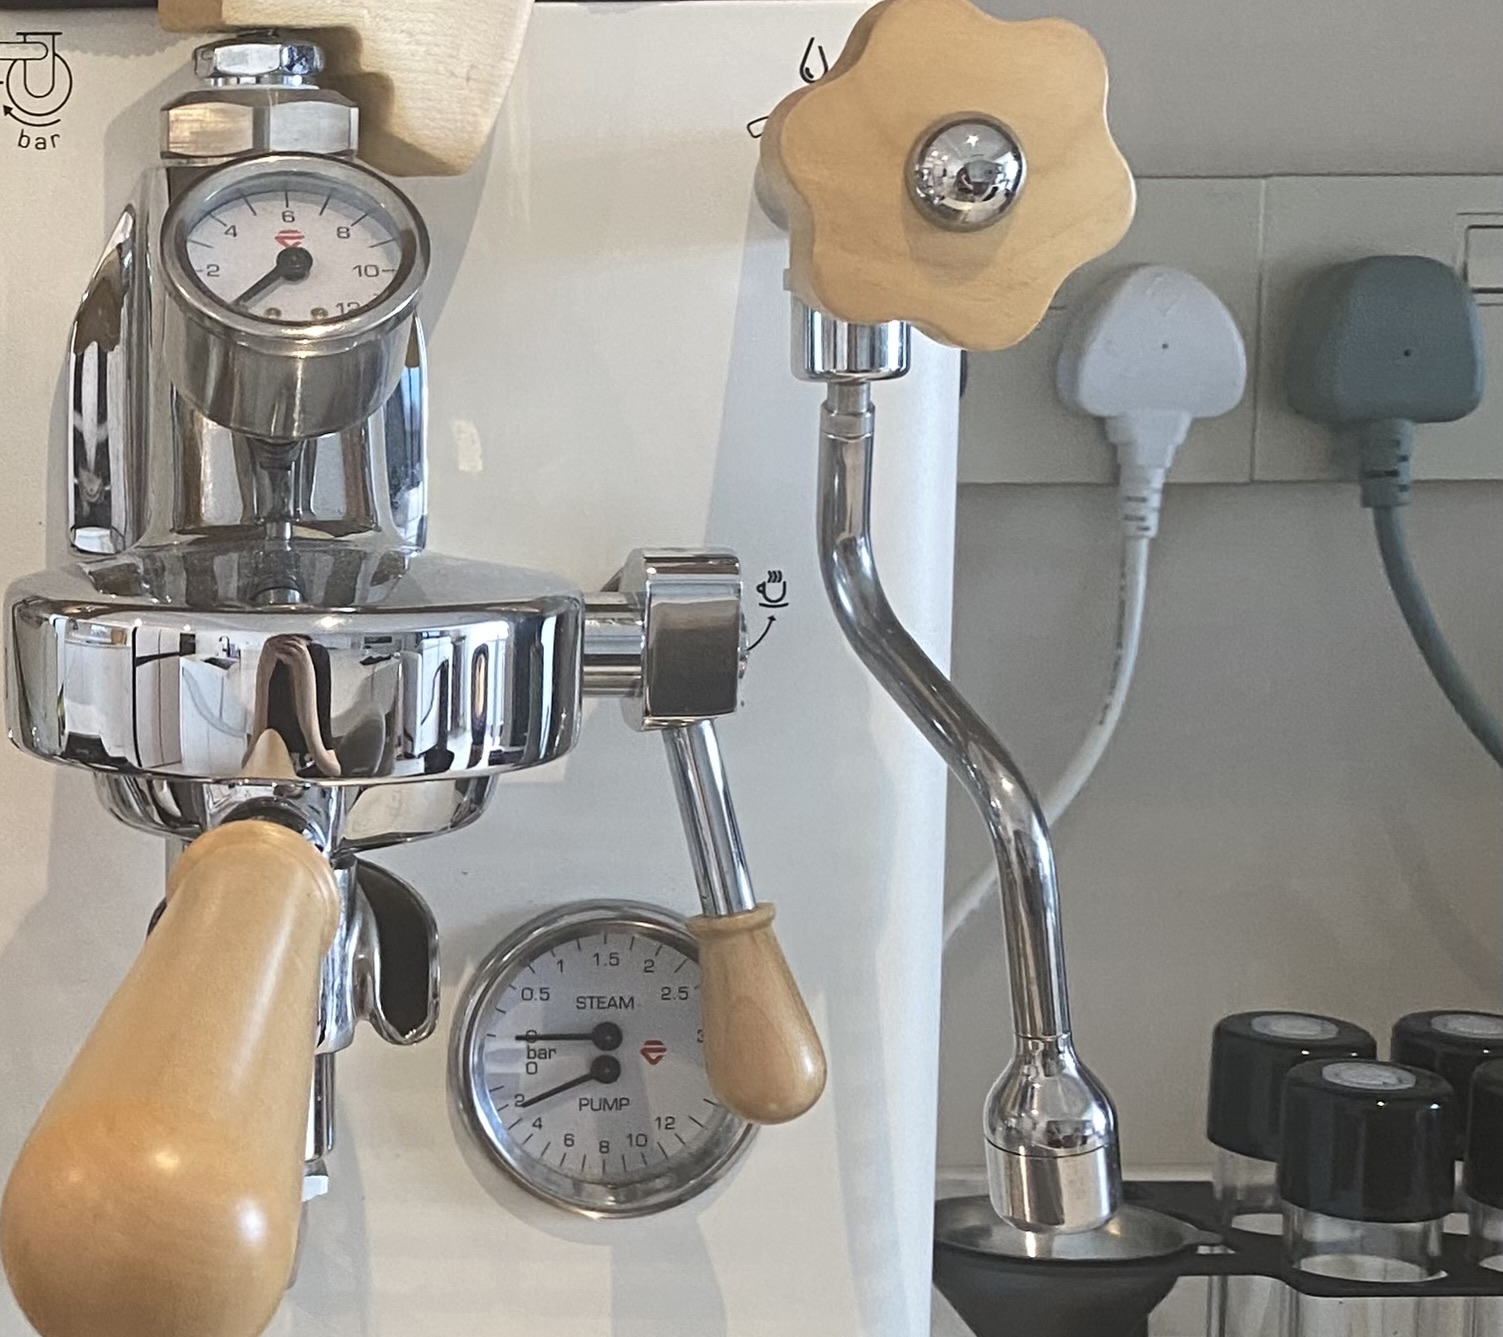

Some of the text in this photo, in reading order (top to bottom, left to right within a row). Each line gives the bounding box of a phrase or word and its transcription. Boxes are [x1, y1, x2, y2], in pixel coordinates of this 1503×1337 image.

[16, 127, 62, 151] bar
[281, 209, 296, 224] 6
[223, 224, 238, 238] 4
[336, 225, 351, 240] 8
[206, 263, 220, 278] 2
[352, 264, 380, 278] 10
[556, 958, 564, 973] 1
[592, 951, 620, 967] 1.5
[643, 958, 655, 974] 2
[521, 986, 551, 1002] 0.5
[660, 985, 689, 1001] 2.5
[575, 995, 635, 1011] STEAM
[526, 1044, 558, 1060] bar
[525, 1060, 539, 1076] 0
[578, 1096, 631, 1112] PUMP
[531, 1116, 543, 1130] 4
[654, 1115, 676, 1131] 12
[563, 1132, 575, 1148] 6
[598, 1139, 611, 1155] 8
[626, 1132, 649, 1148] 10
